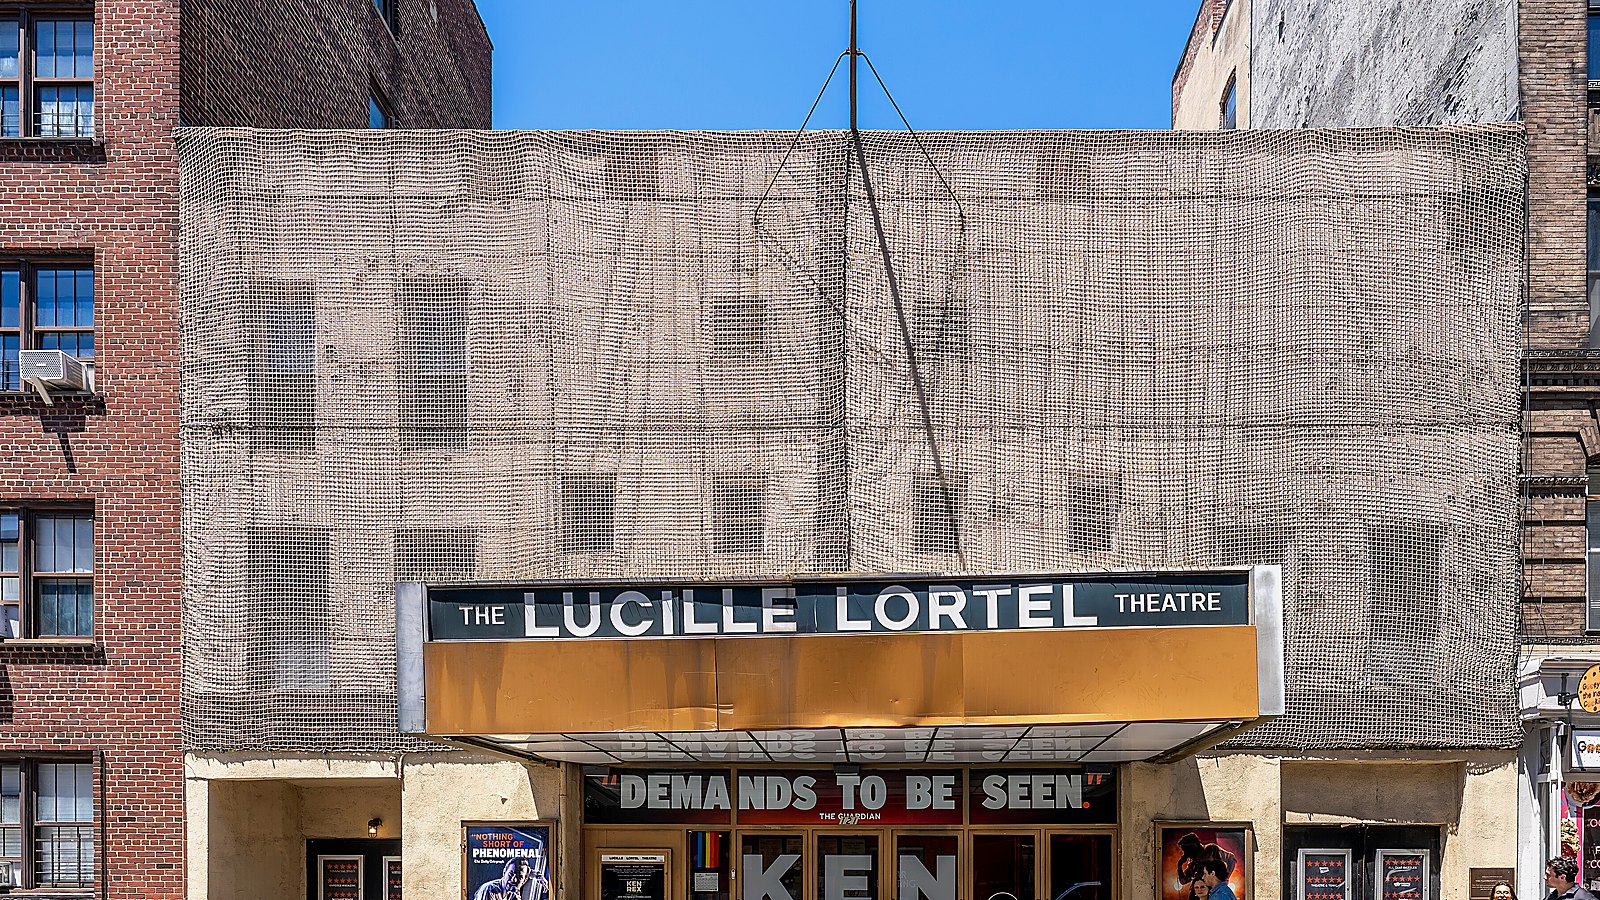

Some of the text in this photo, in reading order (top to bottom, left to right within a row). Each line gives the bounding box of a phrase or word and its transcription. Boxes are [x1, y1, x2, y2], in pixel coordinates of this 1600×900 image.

[458, 582, 1222, 637] THE LUCILLE LORTEL THEATRE
[836, 773, 887, 810] TO
[905, 774, 956, 810] BE
[819, 812, 881, 820] THE GUARDIAN
[743, 854, 956, 900] KEN
